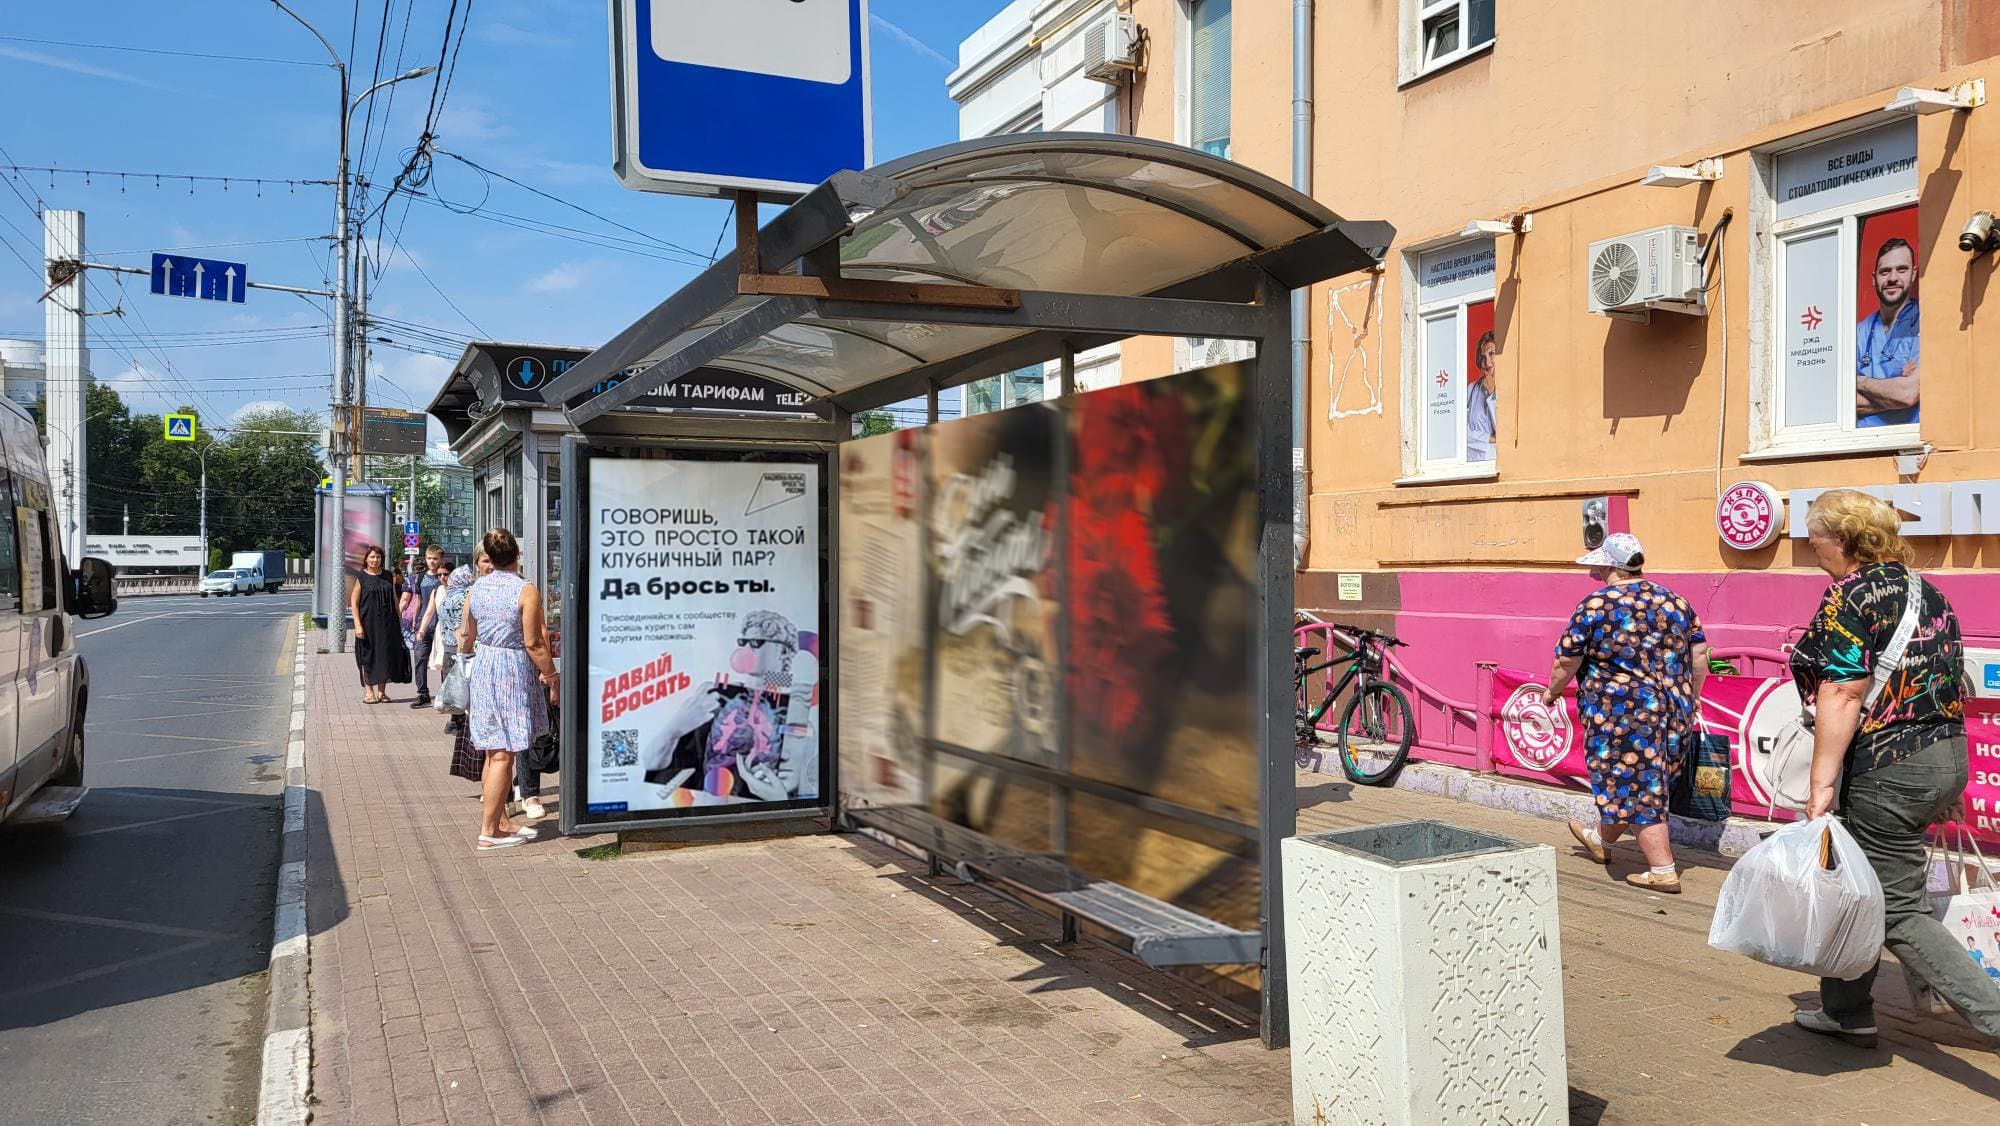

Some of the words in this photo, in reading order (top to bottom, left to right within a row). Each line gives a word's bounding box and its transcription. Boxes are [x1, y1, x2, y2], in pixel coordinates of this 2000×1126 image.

[1828, 156, 1844, 172] ВСЕ
[1846, 149, 1874, 167] ВИДЫ
[1788, 165, 1885, 200] СТОМАТОЛОГИЧЕСКИХ
[1886, 155, 1917, 176] УСЛУГ
[1430, 260, 1453, 274] НАСТАЛО
[1453, 255, 1472, 269] ВРЕМЯ
[1803, 336, 1820, 346] ржд
[681, 383, 765, 401] ТАРИФАМ
[1727, 489, 1763, 505] КУПИ
[600, 508, 719, 526] ГОВОРИШЬ,
[601, 530, 645, 546] ЭТО
[655, 529, 738, 546] ПРОСТО
[747, 526, 806, 545] ТАКОЙ
[732, 550, 776, 567] ПАР?
[600, 578, 641, 600] Да
[646, 577, 730, 600] брось
[734, 579, 776, 594] ты.
[601, 612, 674, 624] Присоединяйся
[601, 622, 643, 633] Бросишь
[644, 622, 676, 632] курить
[608, 634, 642, 644] другим
[601, 651, 673, 704] ДАВАЙ
[601, 671, 692, 724] БРОСАТЬ
